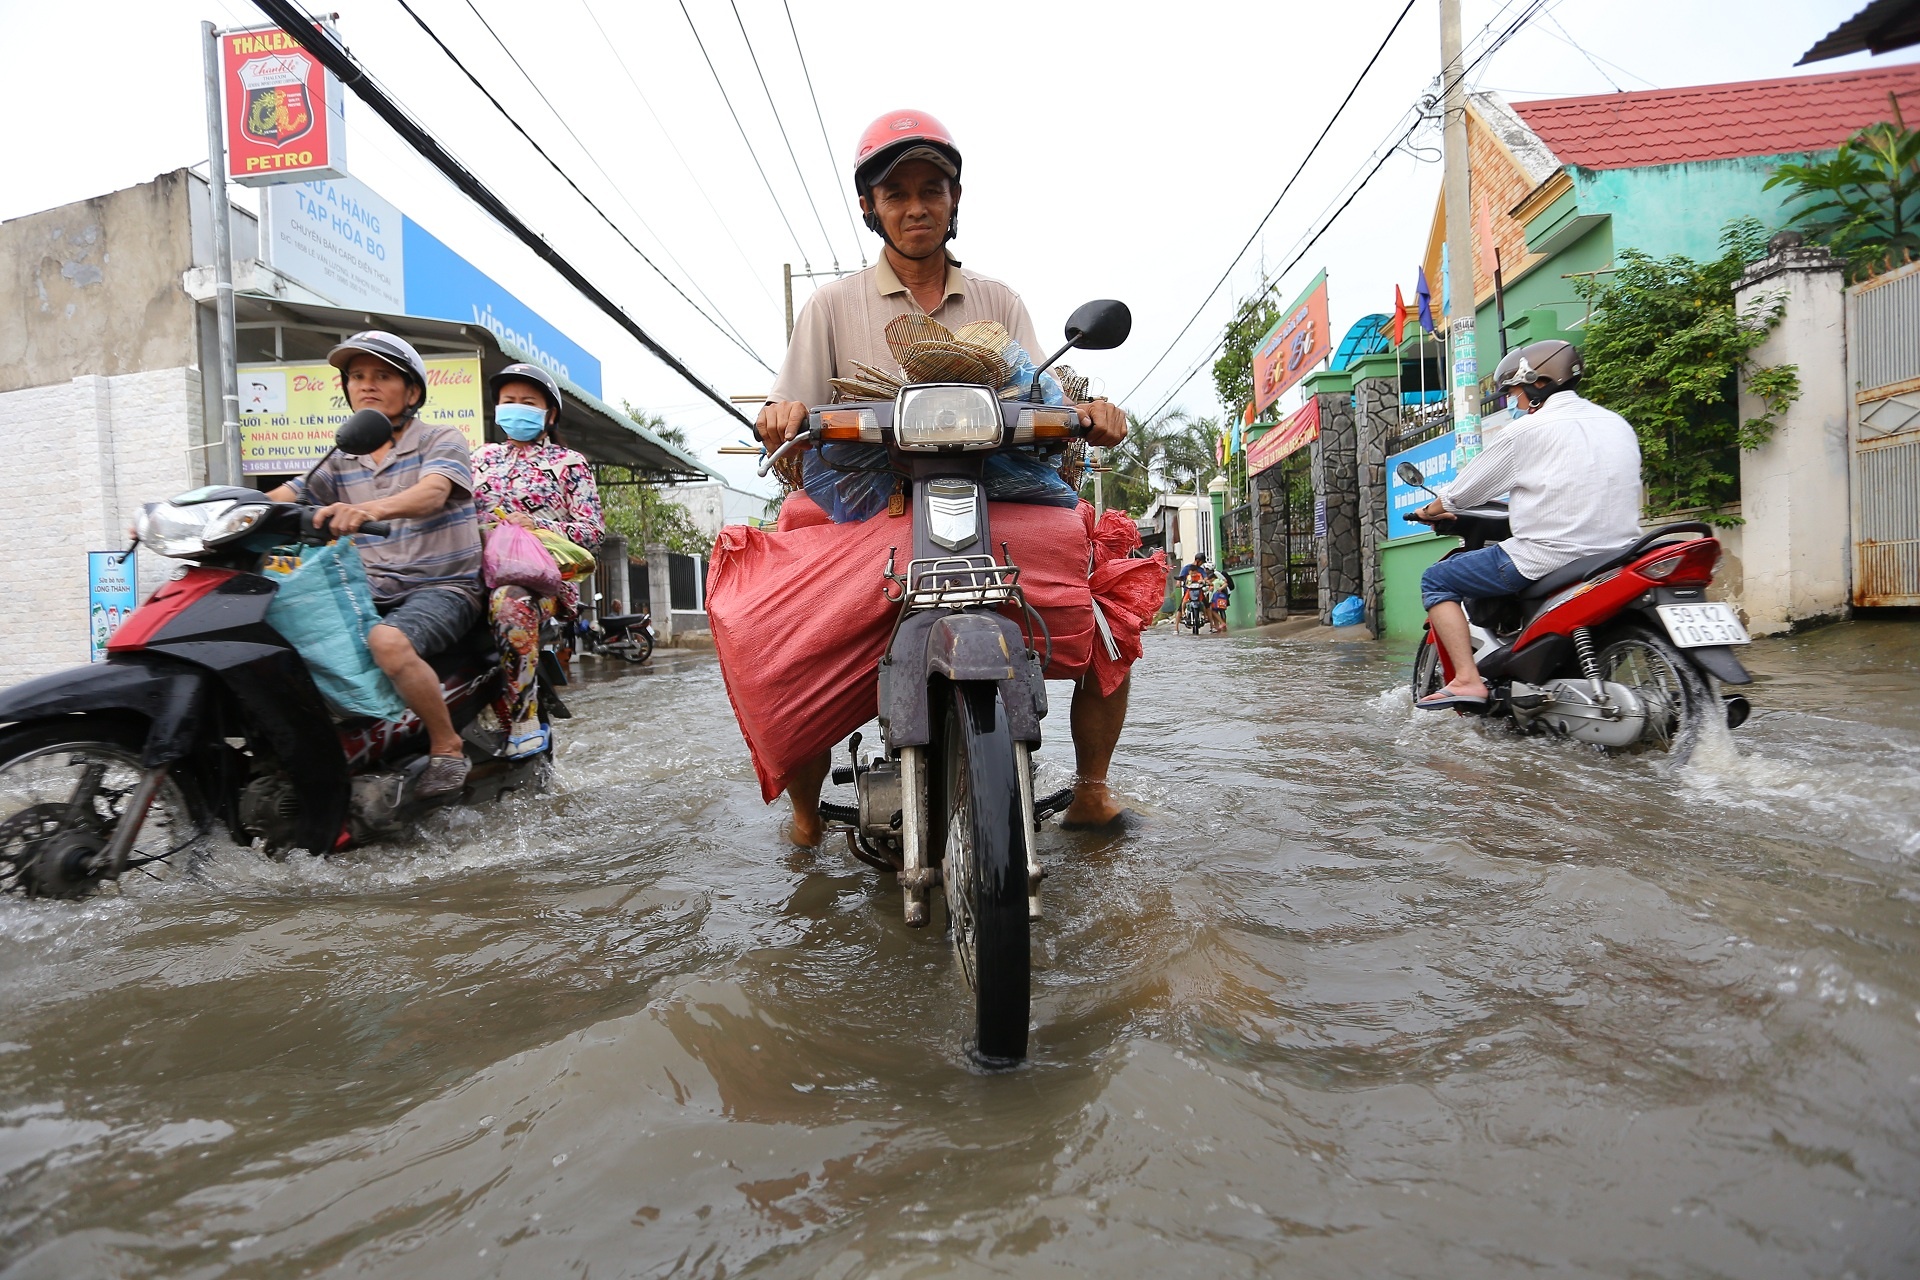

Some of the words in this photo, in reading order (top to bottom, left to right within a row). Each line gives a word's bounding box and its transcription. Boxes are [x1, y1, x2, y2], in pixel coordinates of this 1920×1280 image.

[246, 151, 313, 171] PETRO
[295, 190, 328, 222] TẠP
[331, 214, 363, 249] HÓA
[341, 194, 380, 235] HÀNG
[471, 304, 570, 382] vinaphone
[292, 374, 325, 393] Đức
[426, 368, 473, 387] Nhiều
[271, 414, 289, 426] HỎI
[300, 415, 324, 425] LIÊN
[327, 415, 351, 424] HOA
[433, 408, 454, 419] TÂN
[457, 409, 475, 418] GIA
[251, 430, 278, 443] NHẬN
[281, 432, 304, 441] GIAO
[307, 429, 334, 440] HÀNG
[251, 445, 265, 456] CÓ
[268, 446, 295, 457] PHỤC
[297, 446, 311, 456] VỤ
[250, 461, 270, 471] 1658
[271, 460, 283, 470] LÊ
[284, 460, 300, 470] VĂN
[110, 583, 131, 592] THÀNH
[1670, 606, 1726, 624] 59-K2
[1675, 624, 1742, 643] 106.30
